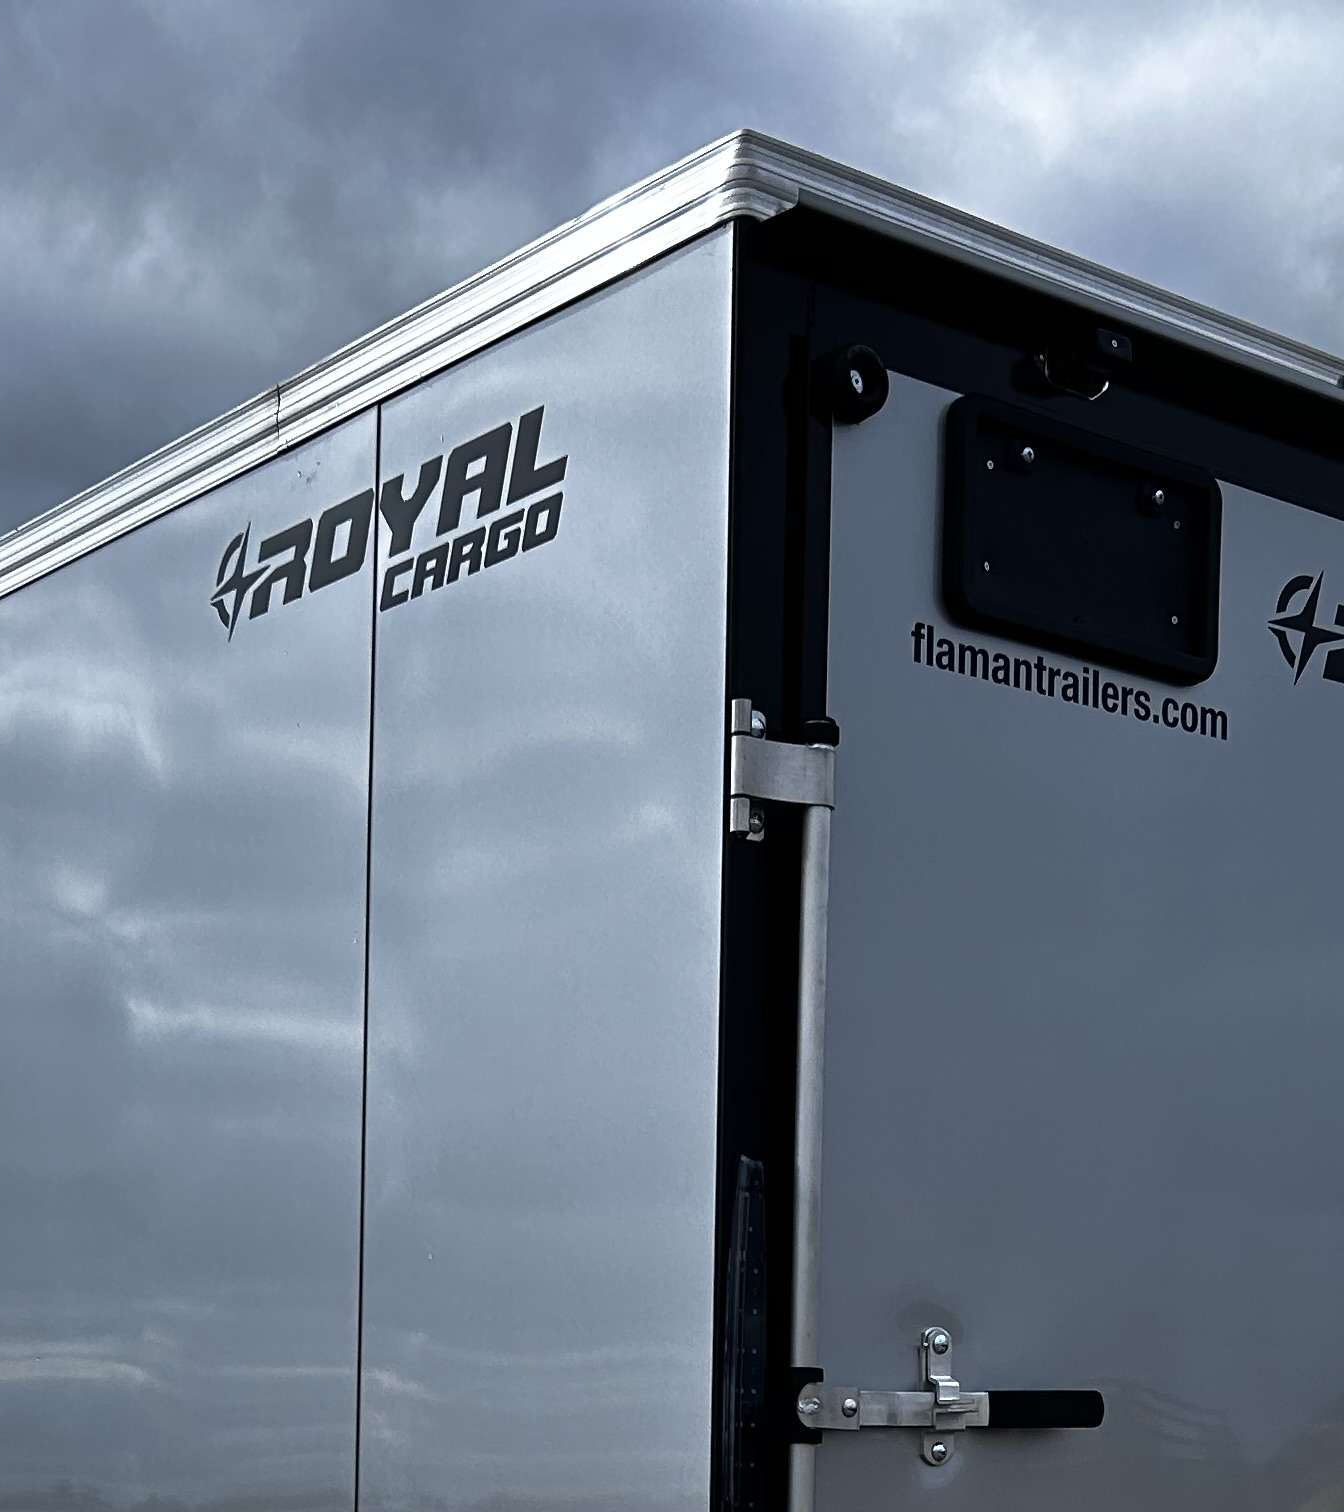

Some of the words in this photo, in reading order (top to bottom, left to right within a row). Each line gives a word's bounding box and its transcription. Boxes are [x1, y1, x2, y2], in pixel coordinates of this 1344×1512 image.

[249, 404, 568, 620] ROYAL
[379, 491, 564, 612] CARGO
[910, 621, 1229, 741] flamantrailers.com
